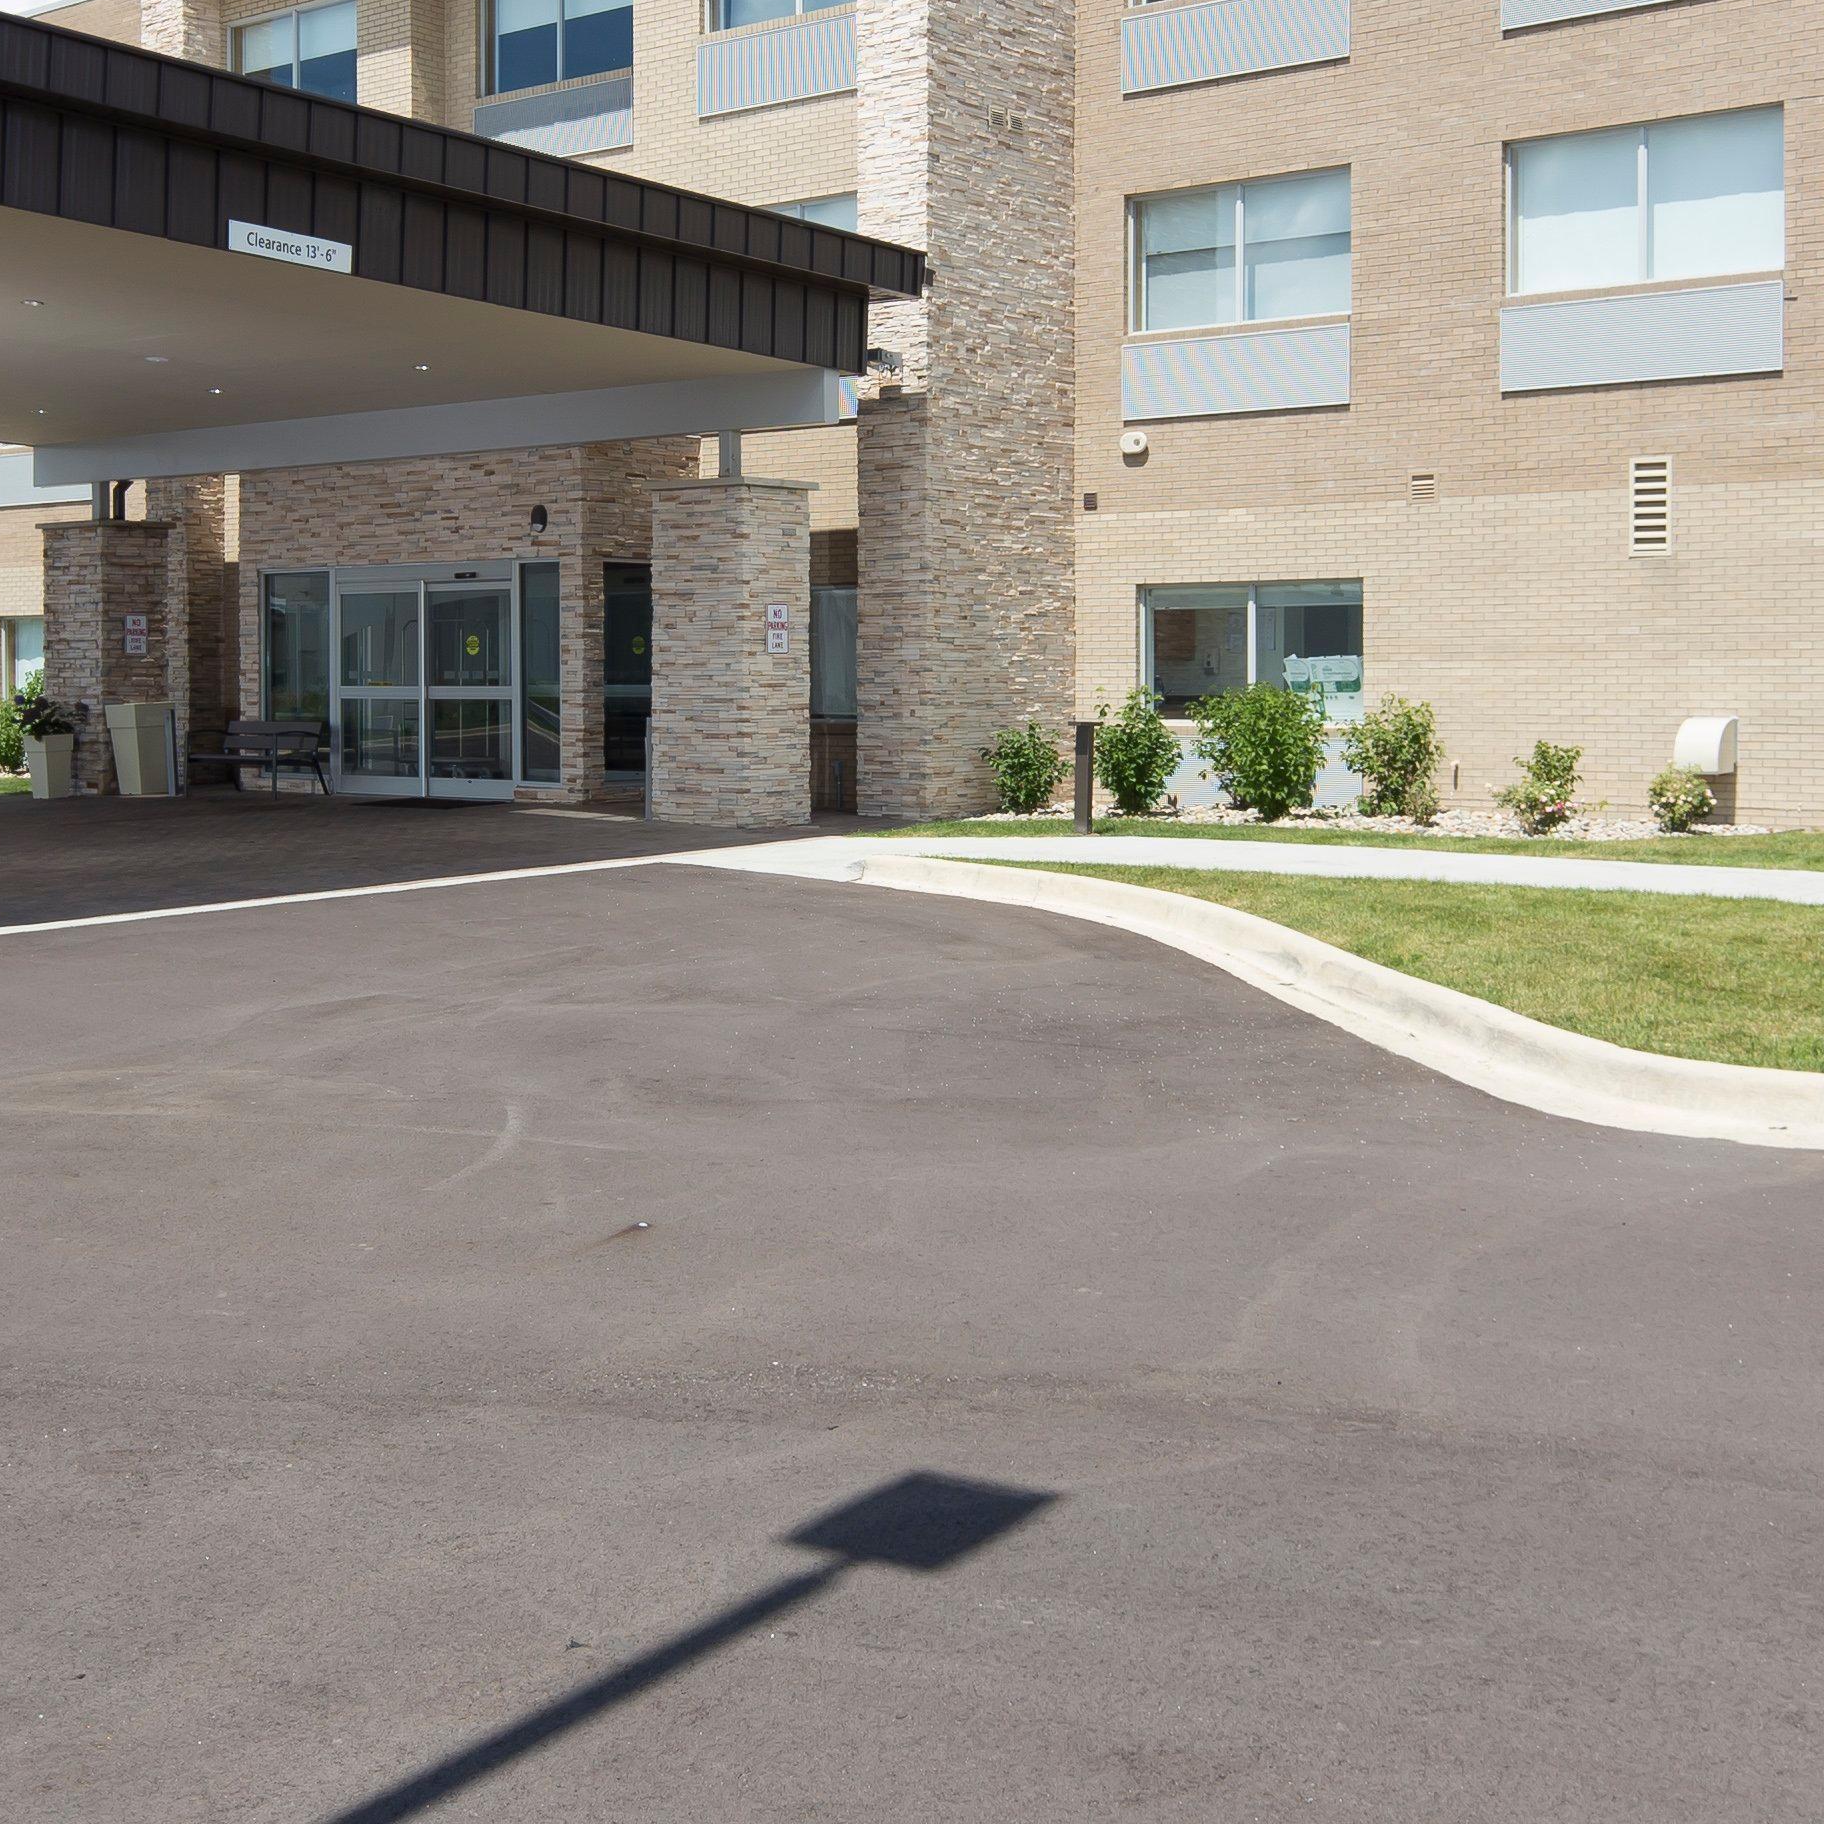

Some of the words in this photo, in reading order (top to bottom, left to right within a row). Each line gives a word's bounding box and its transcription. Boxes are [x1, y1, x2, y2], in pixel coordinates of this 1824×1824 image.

[247, 232, 302, 256] Clearance
[773, 608, 783, 619] NO
[767, 621, 789, 631] PARKING
